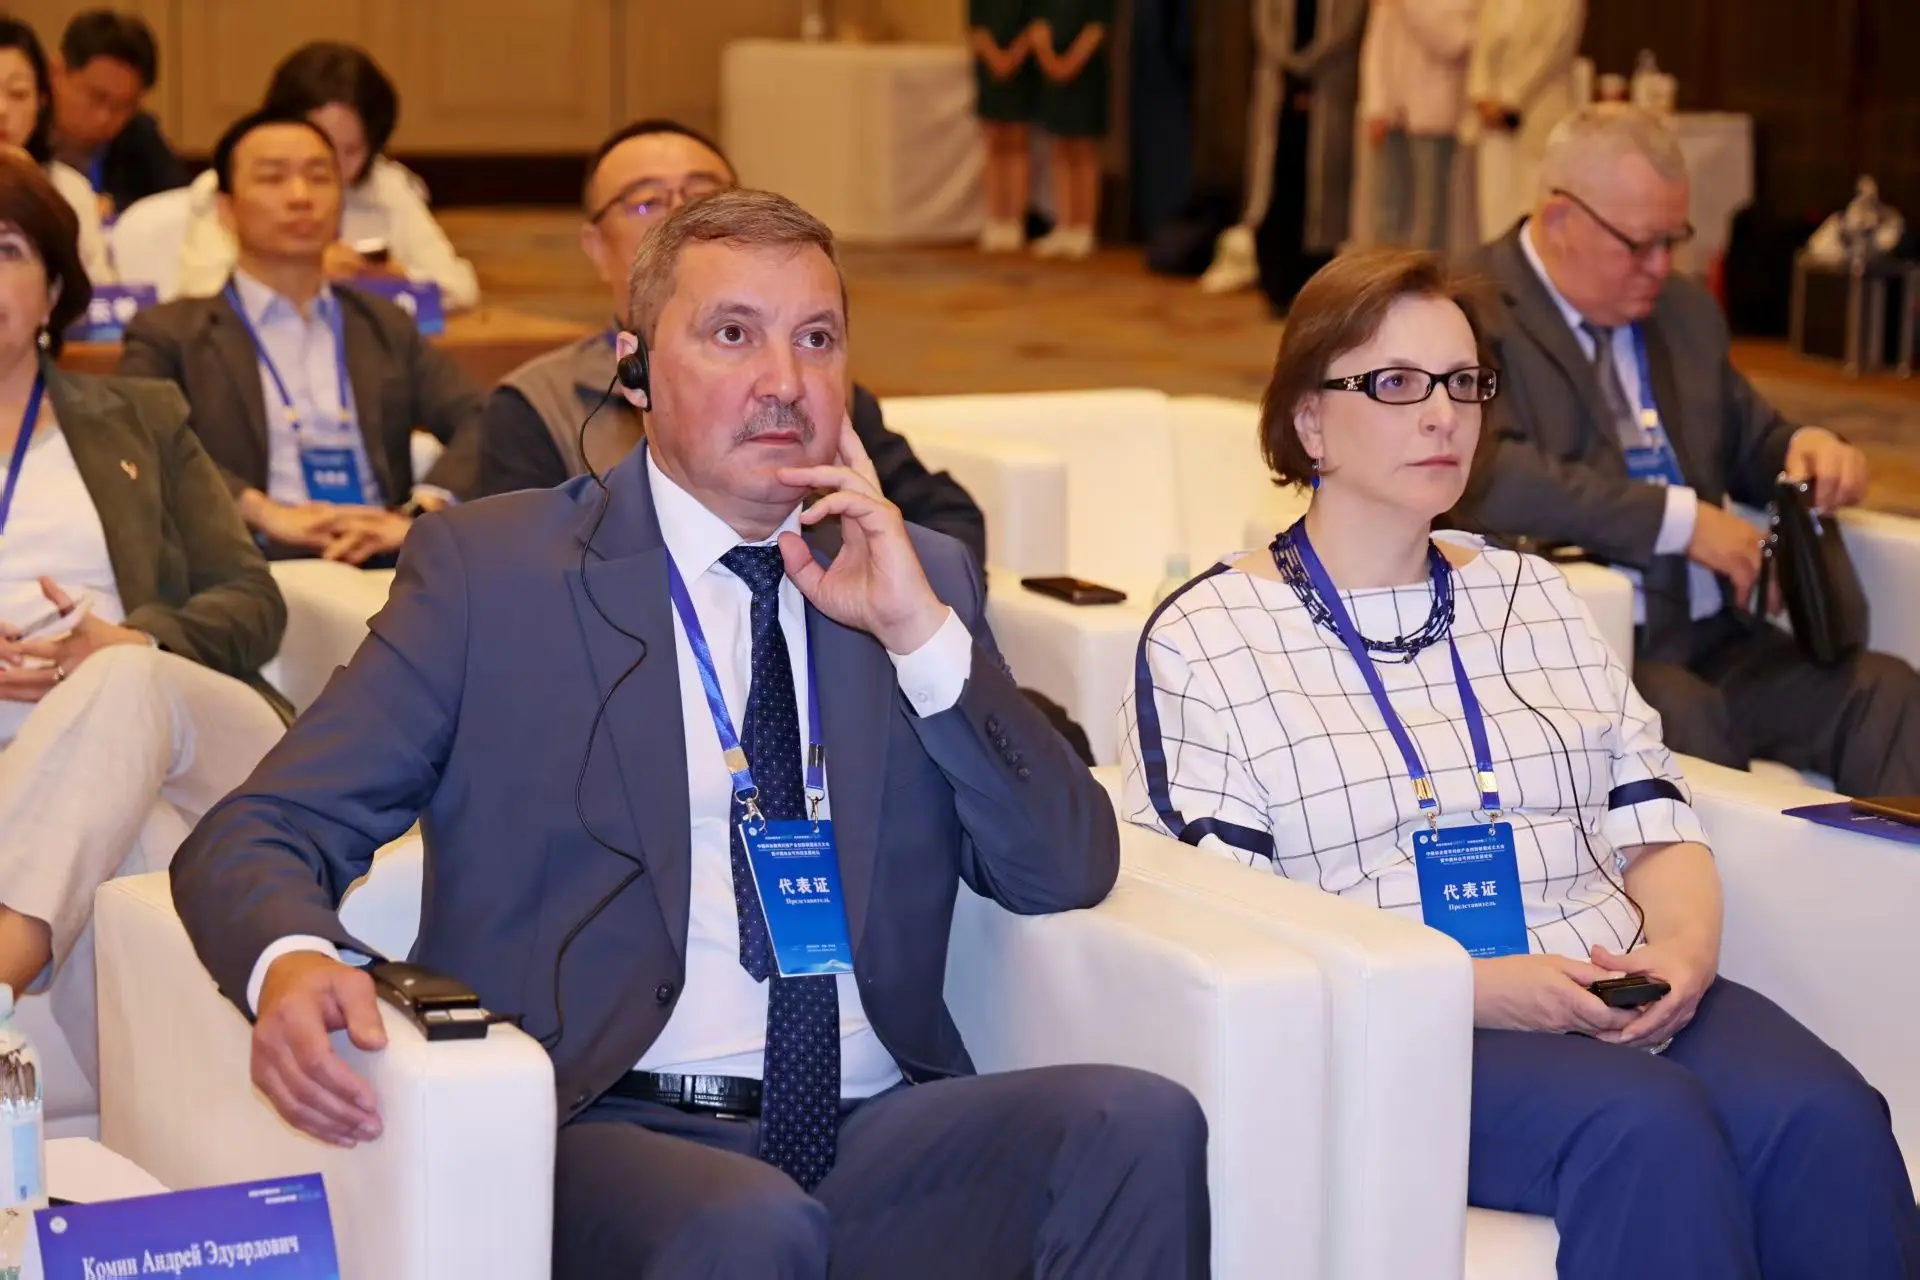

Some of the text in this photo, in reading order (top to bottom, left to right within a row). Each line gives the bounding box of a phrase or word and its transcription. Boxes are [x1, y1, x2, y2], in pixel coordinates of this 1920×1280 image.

[779, 877, 830, 895] 代表证
[1443, 880, 1498, 901] 代表证
[1448, 901, 1497, 912] Представитель
[82, 1234, 300, 1280] Комин Андрей Эдуардович
